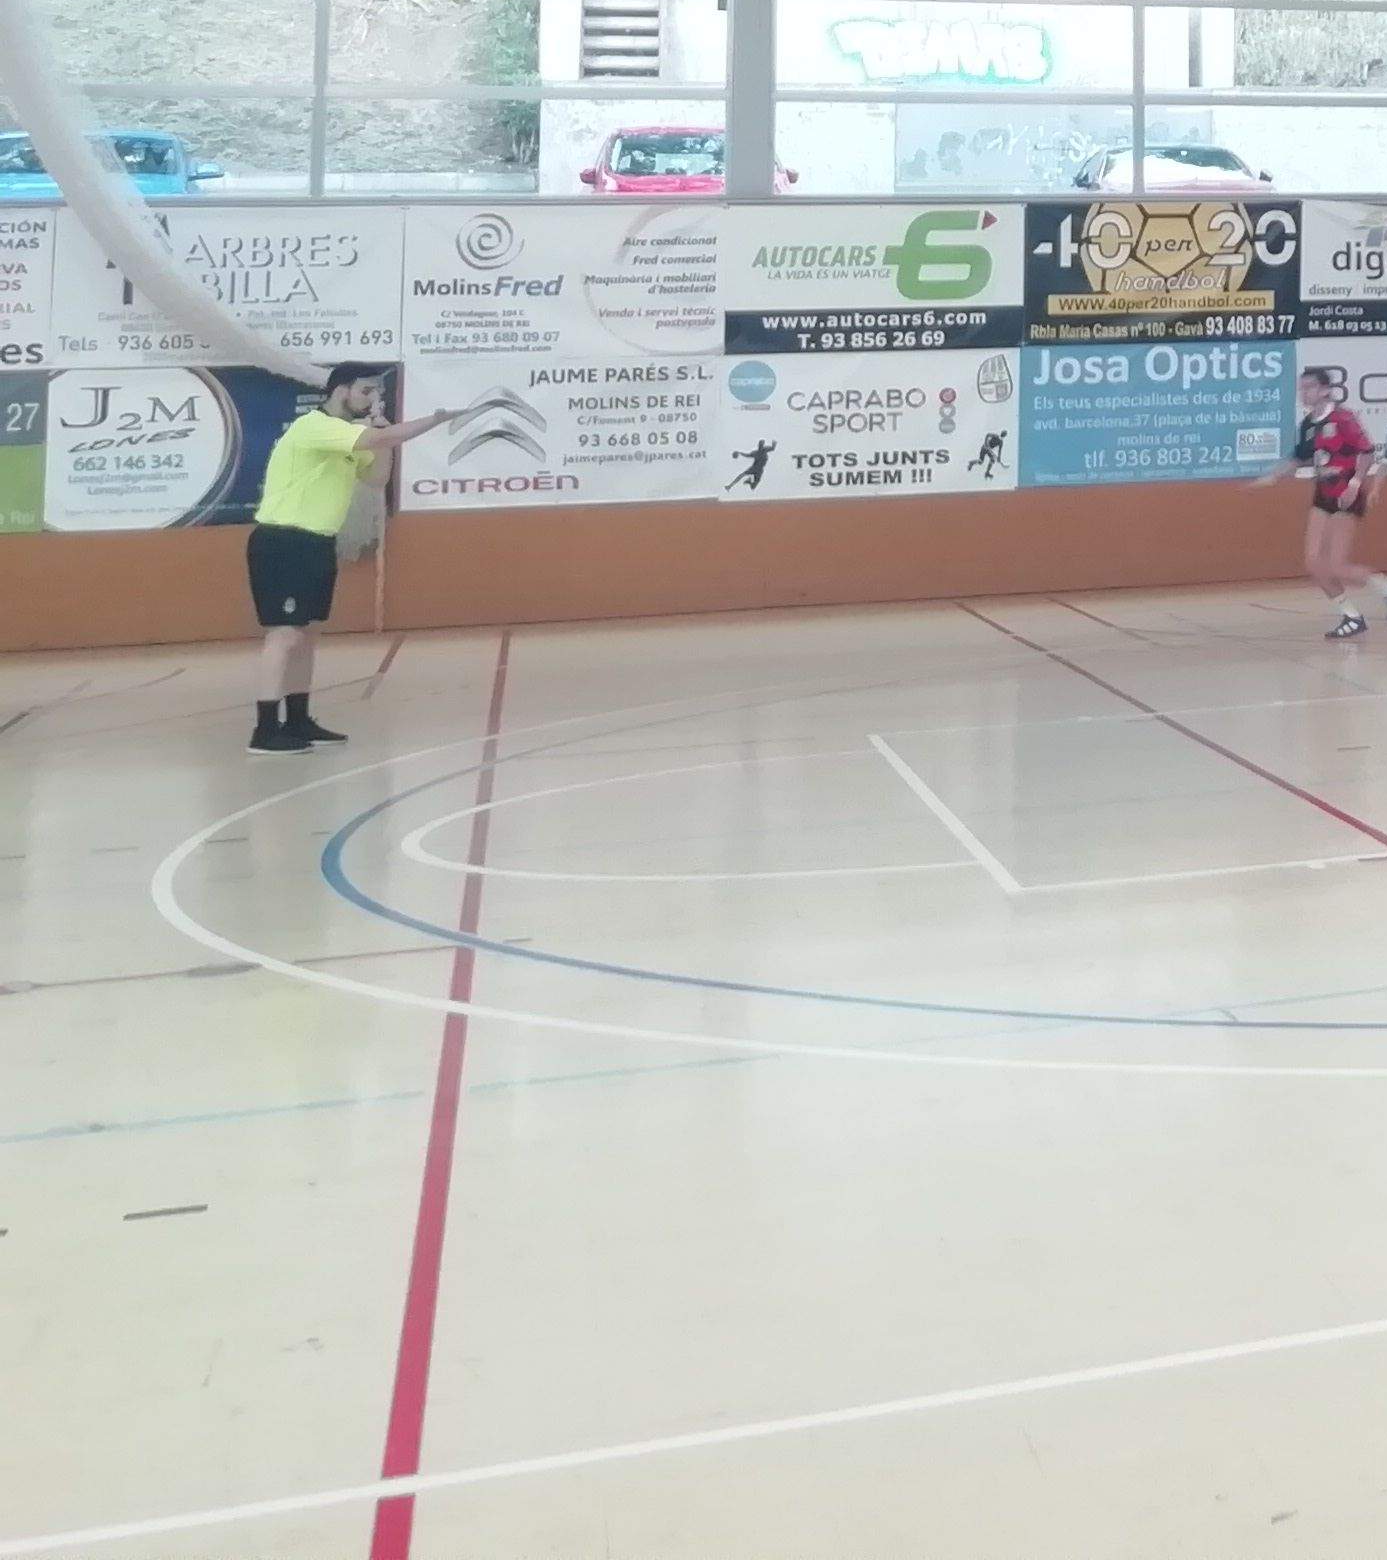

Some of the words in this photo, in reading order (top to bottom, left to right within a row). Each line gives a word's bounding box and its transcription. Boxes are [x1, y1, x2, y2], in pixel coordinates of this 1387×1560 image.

[622, 237, 648, 246] Aire
[1145, 237, 1194, 256] per
[1207, 209, 1297, 266] 20
[661, 254, 717, 264] comercial
[752, 245, 878, 268] AUTOCARS
[663, 272, 716, 283] mobiliari
[768, 269, 782, 280] LA
[786, 268, 813, 280] VIDA
[832, 268, 848, 278] UN
[853, 267, 891, 279] VIATGE
[1115, 269, 1226, 291] handbol
[413, 274, 565, 296] MolinsFred
[1308, 285, 1353, 297] disseny
[598, 308, 635, 318] Venda
[645, 307, 679, 317] servei
[762, 311, 987, 329] www.autocars6.com
[1308, 305, 1333, 317] Jordi
[1334, 306, 1364, 316] Costa
[1093, 323, 1128, 337] Casas
[1147, 322, 1165, 337] 100
[1206, 317, 1223, 335] 93
[1227, 316, 1254, 334] 408
[1257, 316, 1275, 333] 83
[1278, 315, 1295, 333] 77
[1308, 320, 1322, 331] M.
[58, 335, 98, 351] Tels
[118, 335, 152, 351] 936
[159, 334, 194, 349] 605
[280, 332, 314, 347] 656
[320, 331, 351, 346] 991
[360, 330, 394, 345] 693
[411, 334, 431, 345] Tel
[444, 333, 467, 344] Fax
[472, 332, 488, 343] 93
[543, 330, 560, 342] 07
[797, 333, 816, 349] T.
[821, 333, 845, 348] 93
[851, 331, 887, 347] 856
[892, 331, 916, 347] 26
[921, 330, 946, 345] 69
[529, 368, 598, 387] JAUME
[605, 363, 669, 383] PARÉS
[676, 366, 714, 381] S.L.
[1033, 349, 1130, 386] Josa
[1145, 342, 1284, 390] Optics
[568, 396, 640, 411] MOLINS
[646, 395, 669, 408] DE
[675, 394, 701, 407] REI
[787, 388, 926, 412] CAPRABO
[1034, 396, 1054, 411] Els
[1059, 395, 1091, 410] teus
[1095, 392, 1189, 410] especialistes
[1222, 390, 1241, 404] de
[7, 403, 40, 432] 27
[812, 413, 903, 434] SPORT
[1196, 412, 1212, 425] de
[1215, 410, 1226, 423] la
[579, 434, 600, 448] 93
[608, 433, 641, 447] 668
[647, 432, 669, 445] 05
[676, 431, 698, 444] 08
[73, 456, 107, 471] 662
[114, 455, 146, 470] 146
[151, 453, 184, 469] 342
[792, 451, 858, 469] TOTS
[866, 449, 950, 466] JUNTS
[1115, 450, 1151, 468] 936
[1157, 448, 1192, 466] 803
[1199, 446, 1233, 463] 242
[809, 470, 902, 487] SUMEM
[911, 468, 932, 484] !!!
